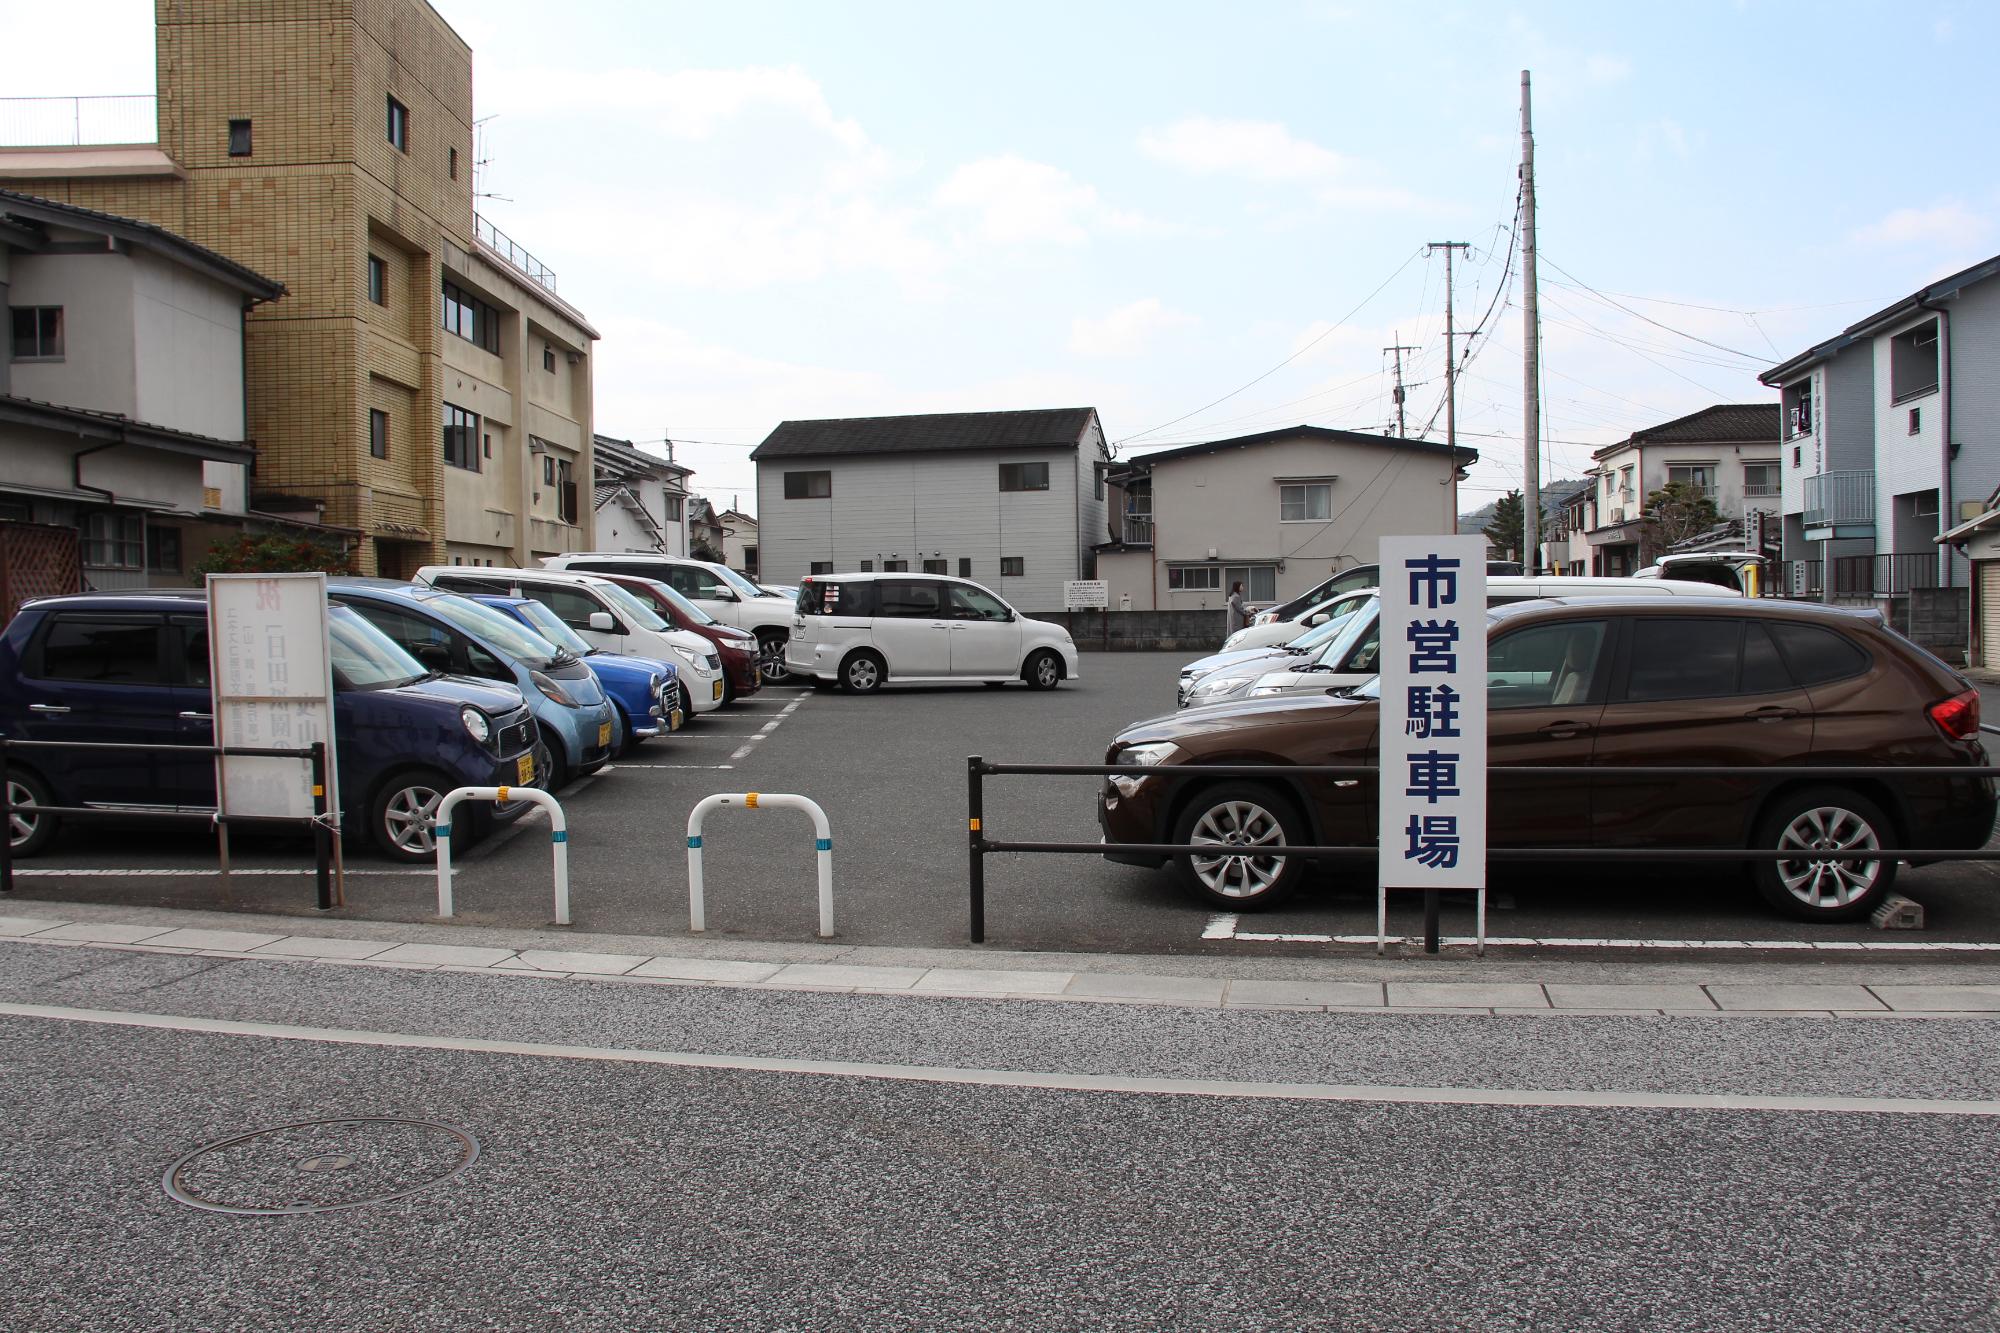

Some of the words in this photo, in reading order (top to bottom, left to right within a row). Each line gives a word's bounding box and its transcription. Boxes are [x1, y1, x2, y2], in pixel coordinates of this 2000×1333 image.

[1404, 553, 1461, 869] 市営駐車場
